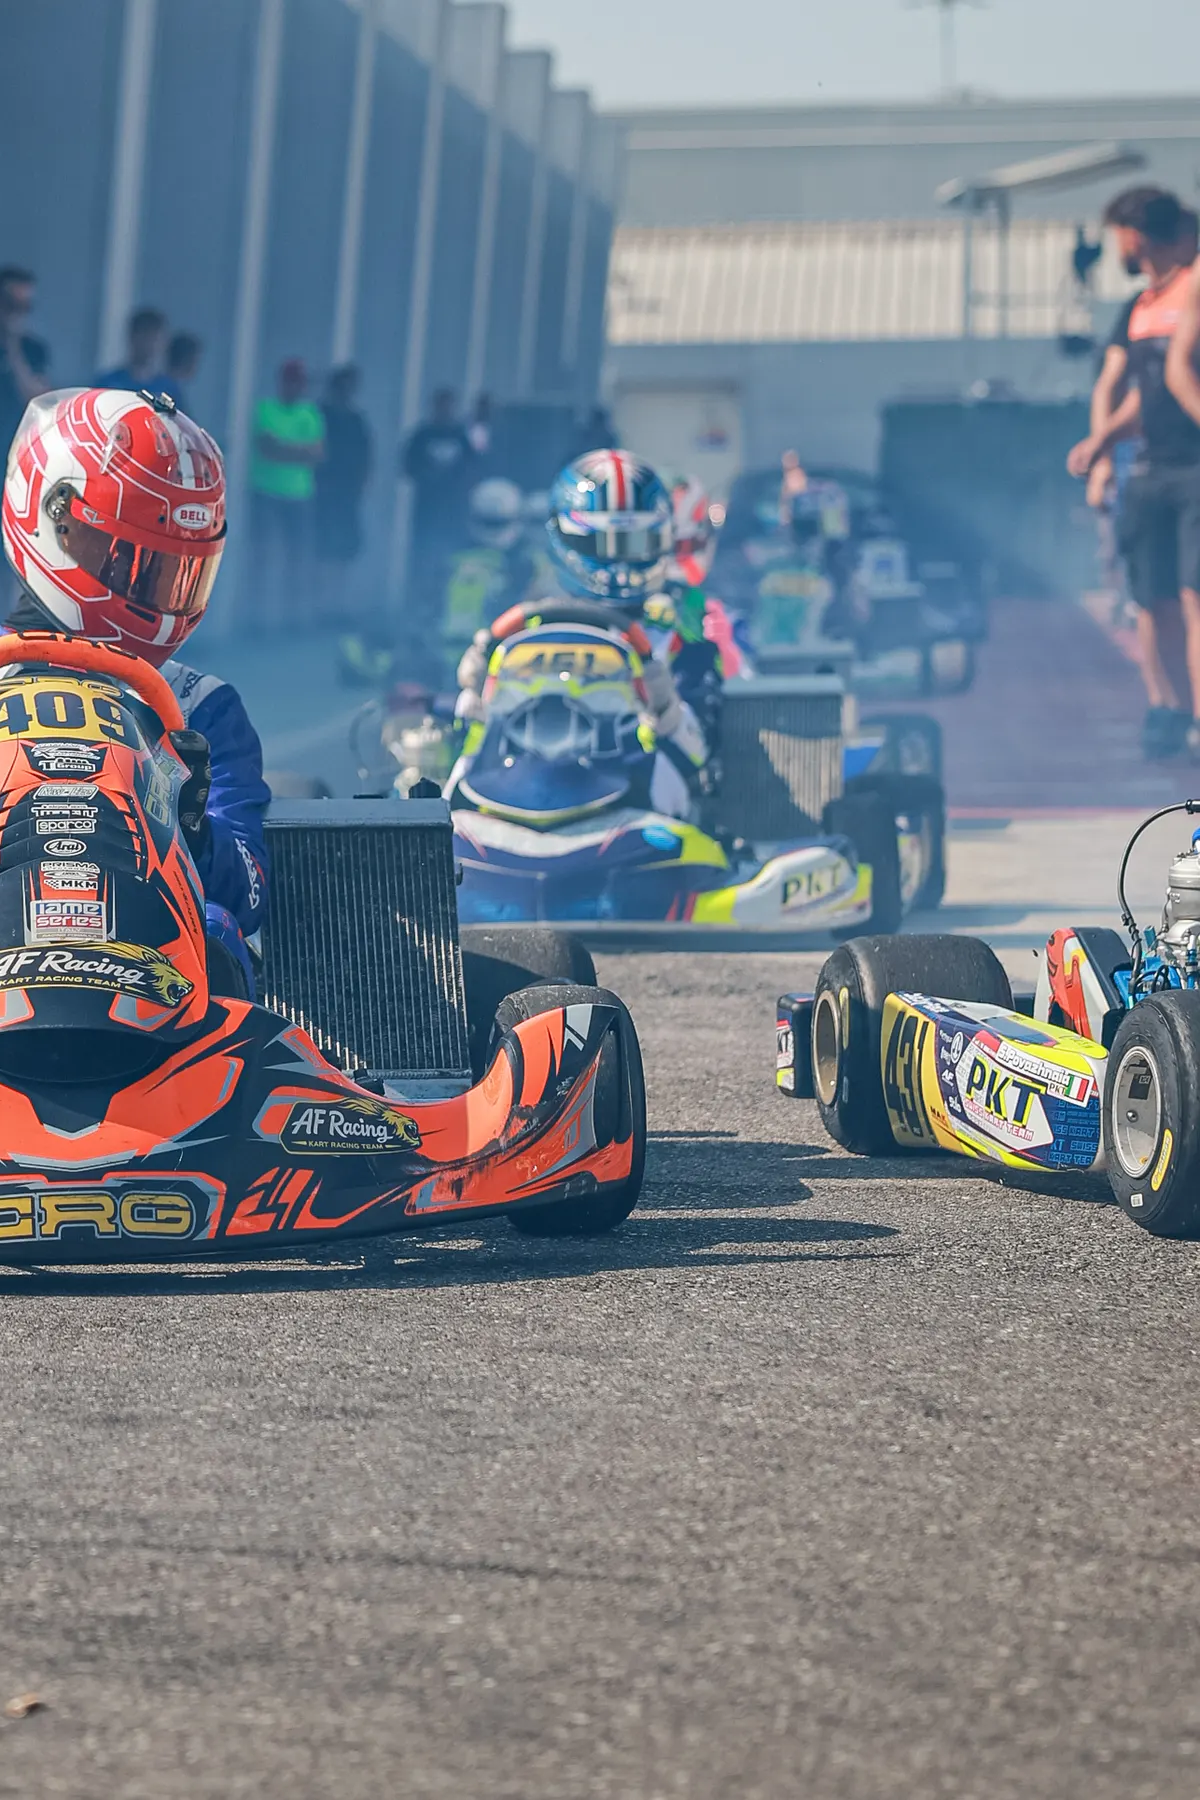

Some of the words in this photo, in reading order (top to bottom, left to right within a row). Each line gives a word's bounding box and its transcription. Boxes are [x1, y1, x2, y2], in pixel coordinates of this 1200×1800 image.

[180, 510, 207, 521] BELL
[39, 820, 92, 832] sparco
[42, 862, 98, 870] PRISMA
[61, 880, 97, 889] MKM
[38, 951, 147, 985] Racing
[35, 975, 83, 983] RACING
[86, 977, 122, 988] TEAM
[966, 1054, 1048, 1127] PKT
[291, 1108, 326, 1134] AF
[329, 1110, 393, 1143] Racing
[1007, 1121, 1035, 1141] TEAM
